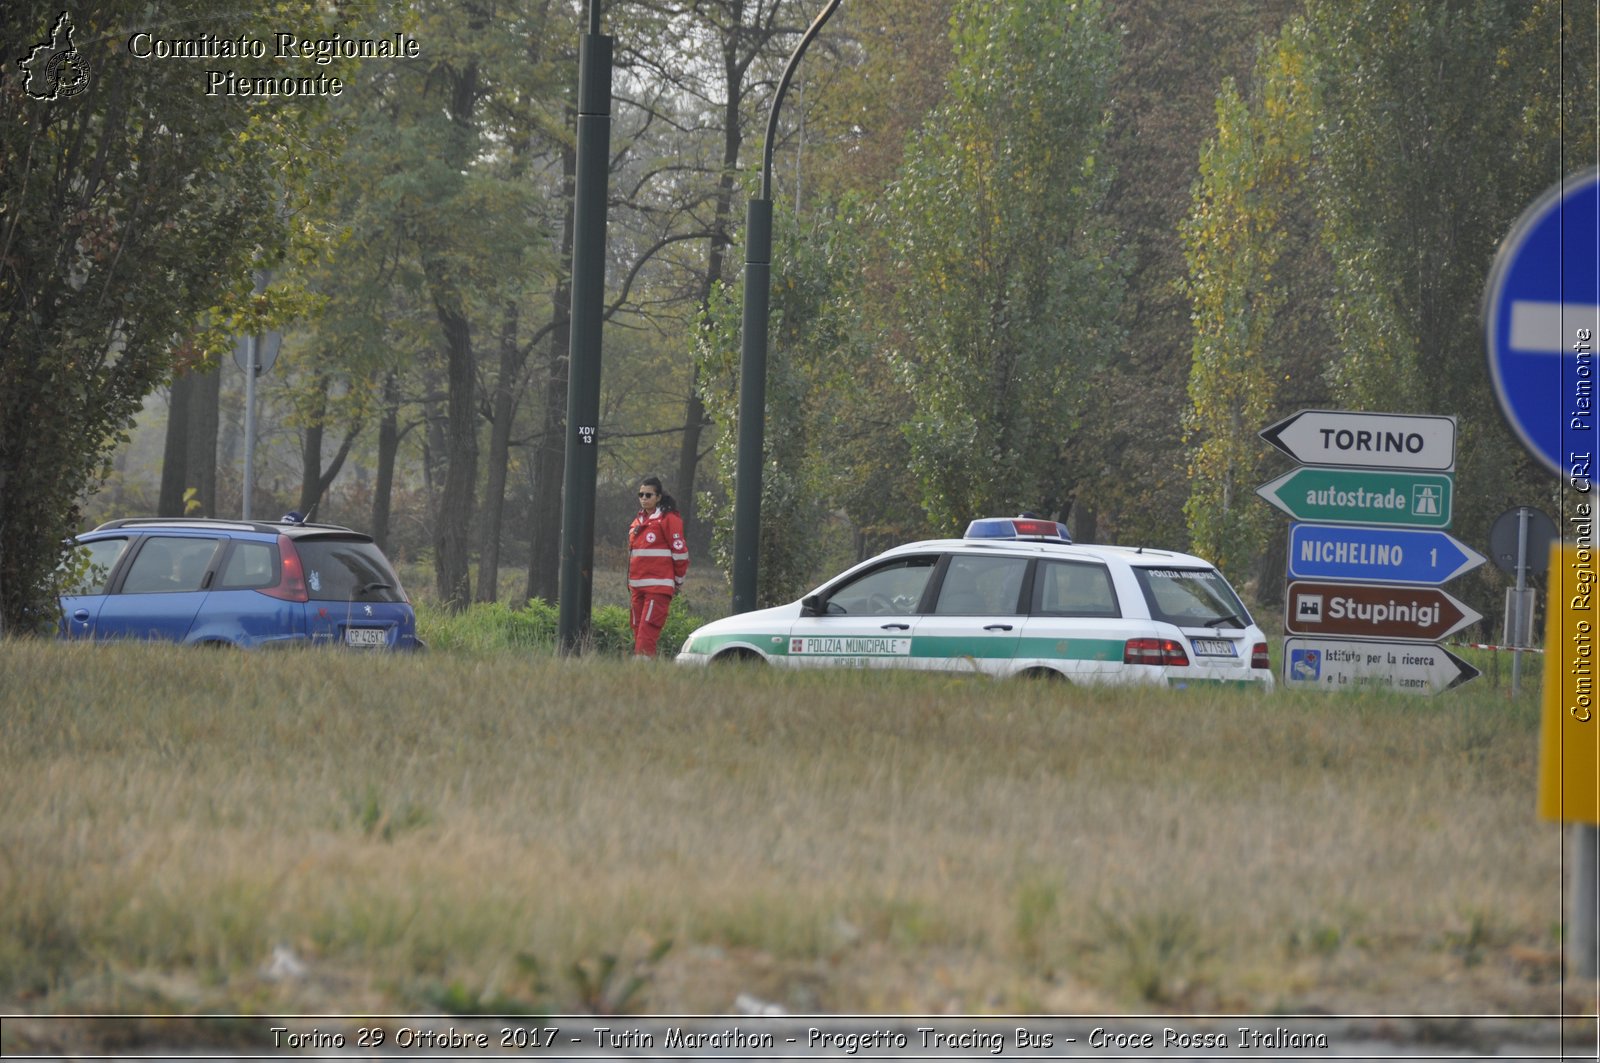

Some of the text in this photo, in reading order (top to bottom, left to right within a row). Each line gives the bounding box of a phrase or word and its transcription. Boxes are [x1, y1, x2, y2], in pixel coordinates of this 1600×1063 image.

[579, 426, 595, 435] XDV
[583, 435, 592, 444] 13
[1319, 428, 1424, 454] TORINO
[1306, 485, 1406, 509] autostrade
[1301, 540, 1437, 567] NICHELINO 1
[1328, 596, 1440, 627] Stupinigi
[807, 639, 897, 653] POLIZIA MUNICIPALE
[1325, 649, 1434, 666] Istituto per la ricerca
[1327, 675, 1333, 684] e
